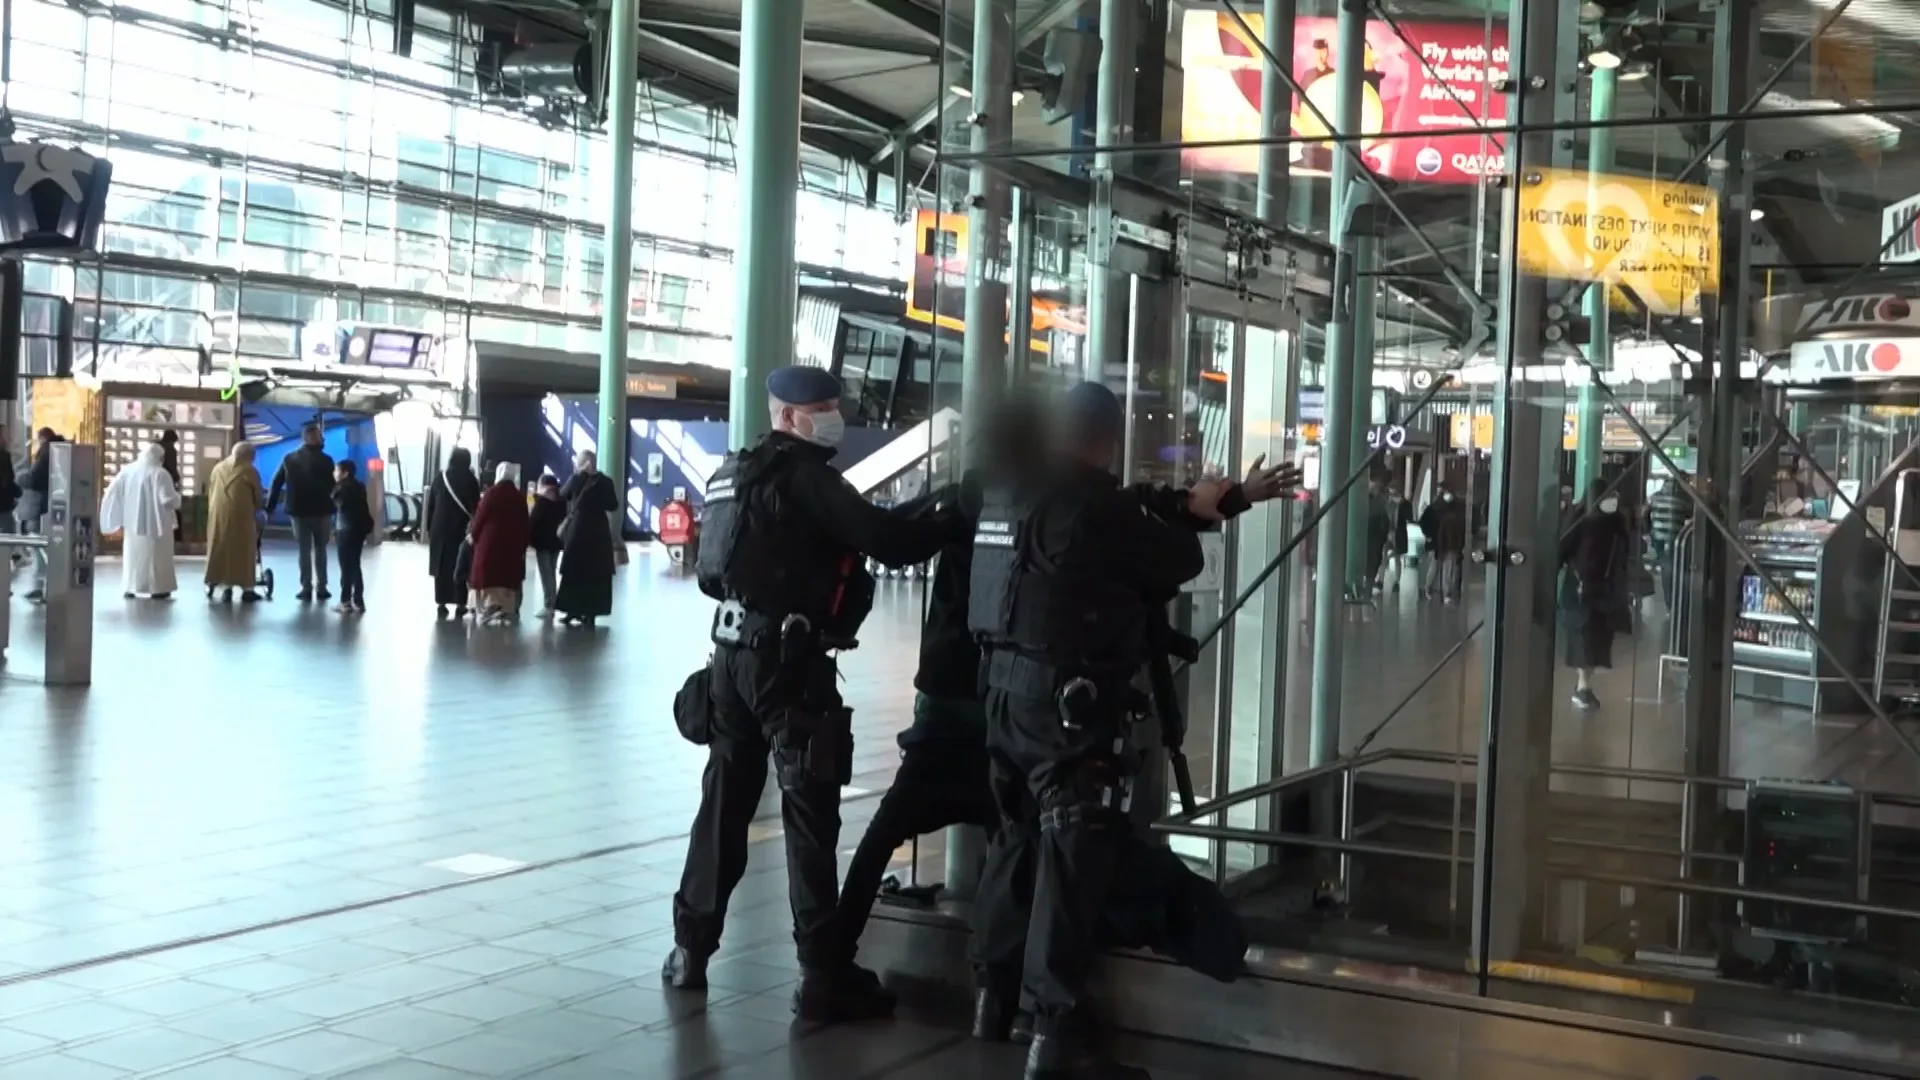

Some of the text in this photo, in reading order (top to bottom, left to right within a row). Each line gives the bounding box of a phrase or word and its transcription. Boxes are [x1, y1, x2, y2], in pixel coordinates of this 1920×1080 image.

[1421, 42, 1509, 64] Fly with th
[1420, 64, 1484, 82] World's
[1419, 84, 1476, 102] Airline
